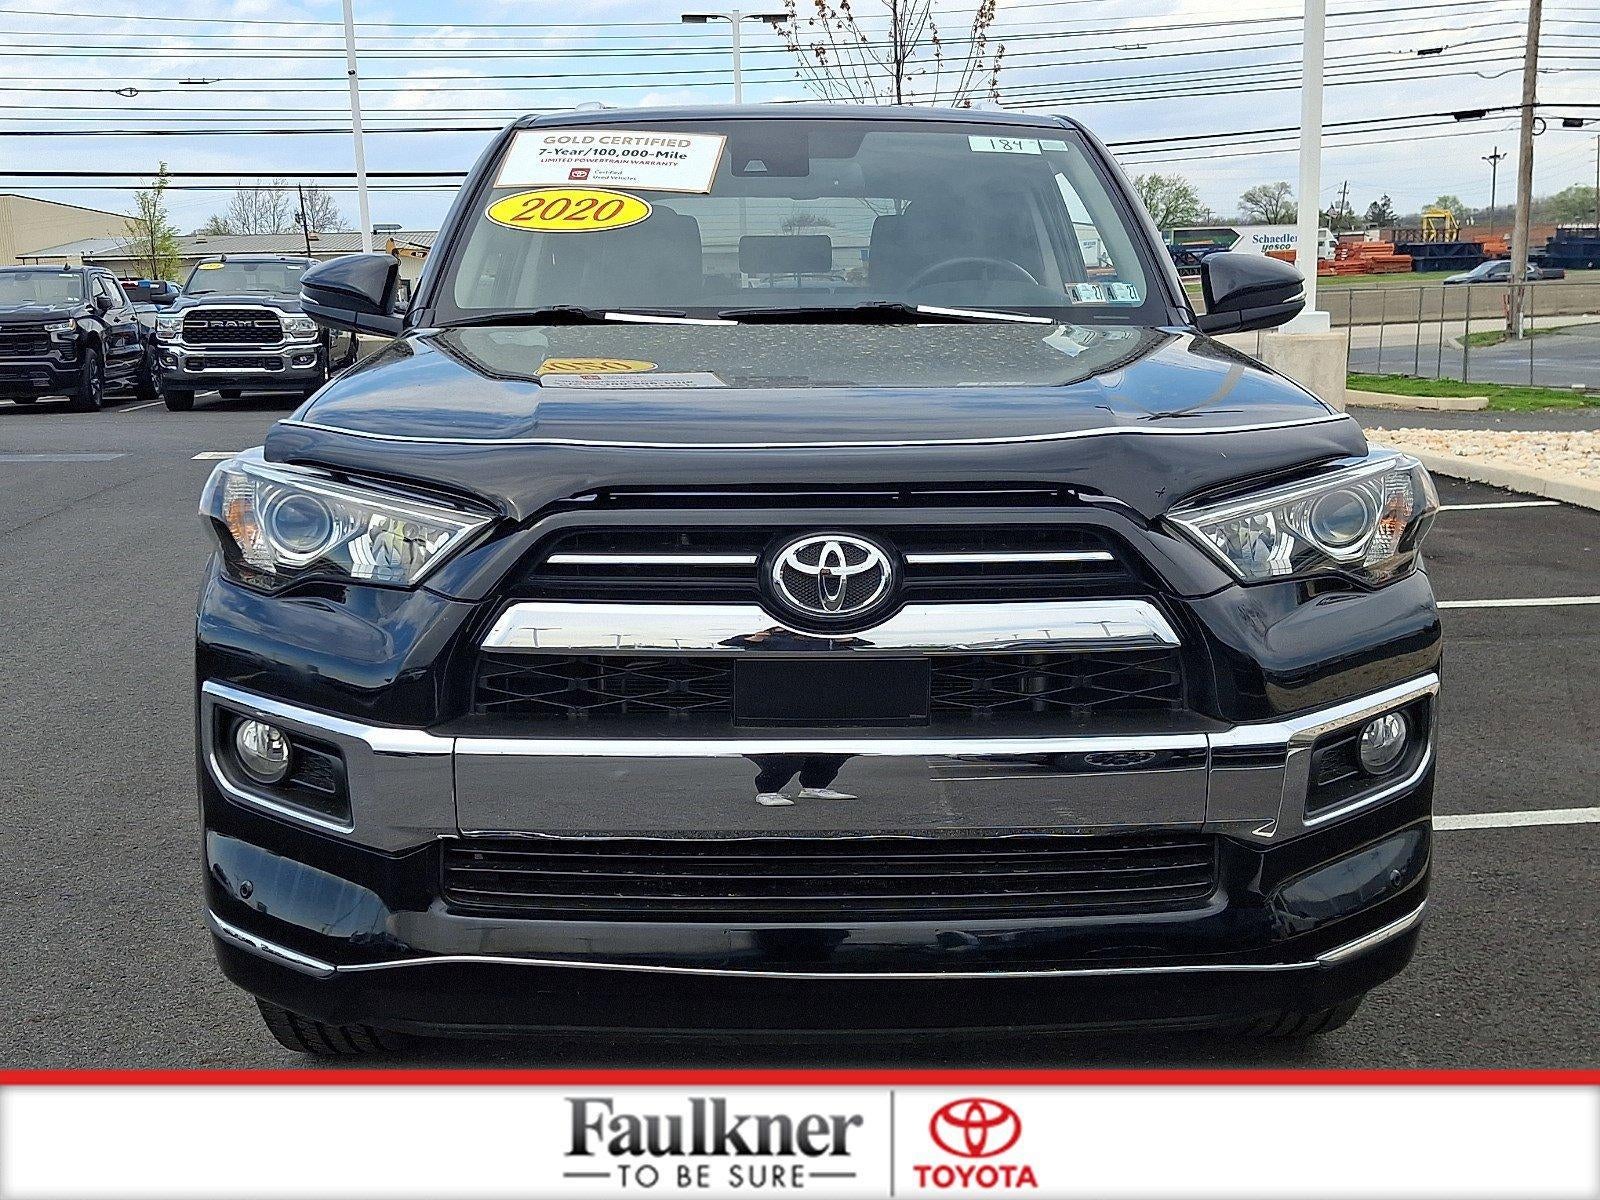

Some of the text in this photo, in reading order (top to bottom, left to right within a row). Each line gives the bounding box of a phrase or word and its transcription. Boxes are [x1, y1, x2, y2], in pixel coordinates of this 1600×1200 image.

[543, 136, 691, 148] GOLD CERTIFIED
[539, 148, 688, 160] 7-Year/100,000-Mile
[510, 197, 625, 221] 2020
[210, 320, 252, 328] RAM
